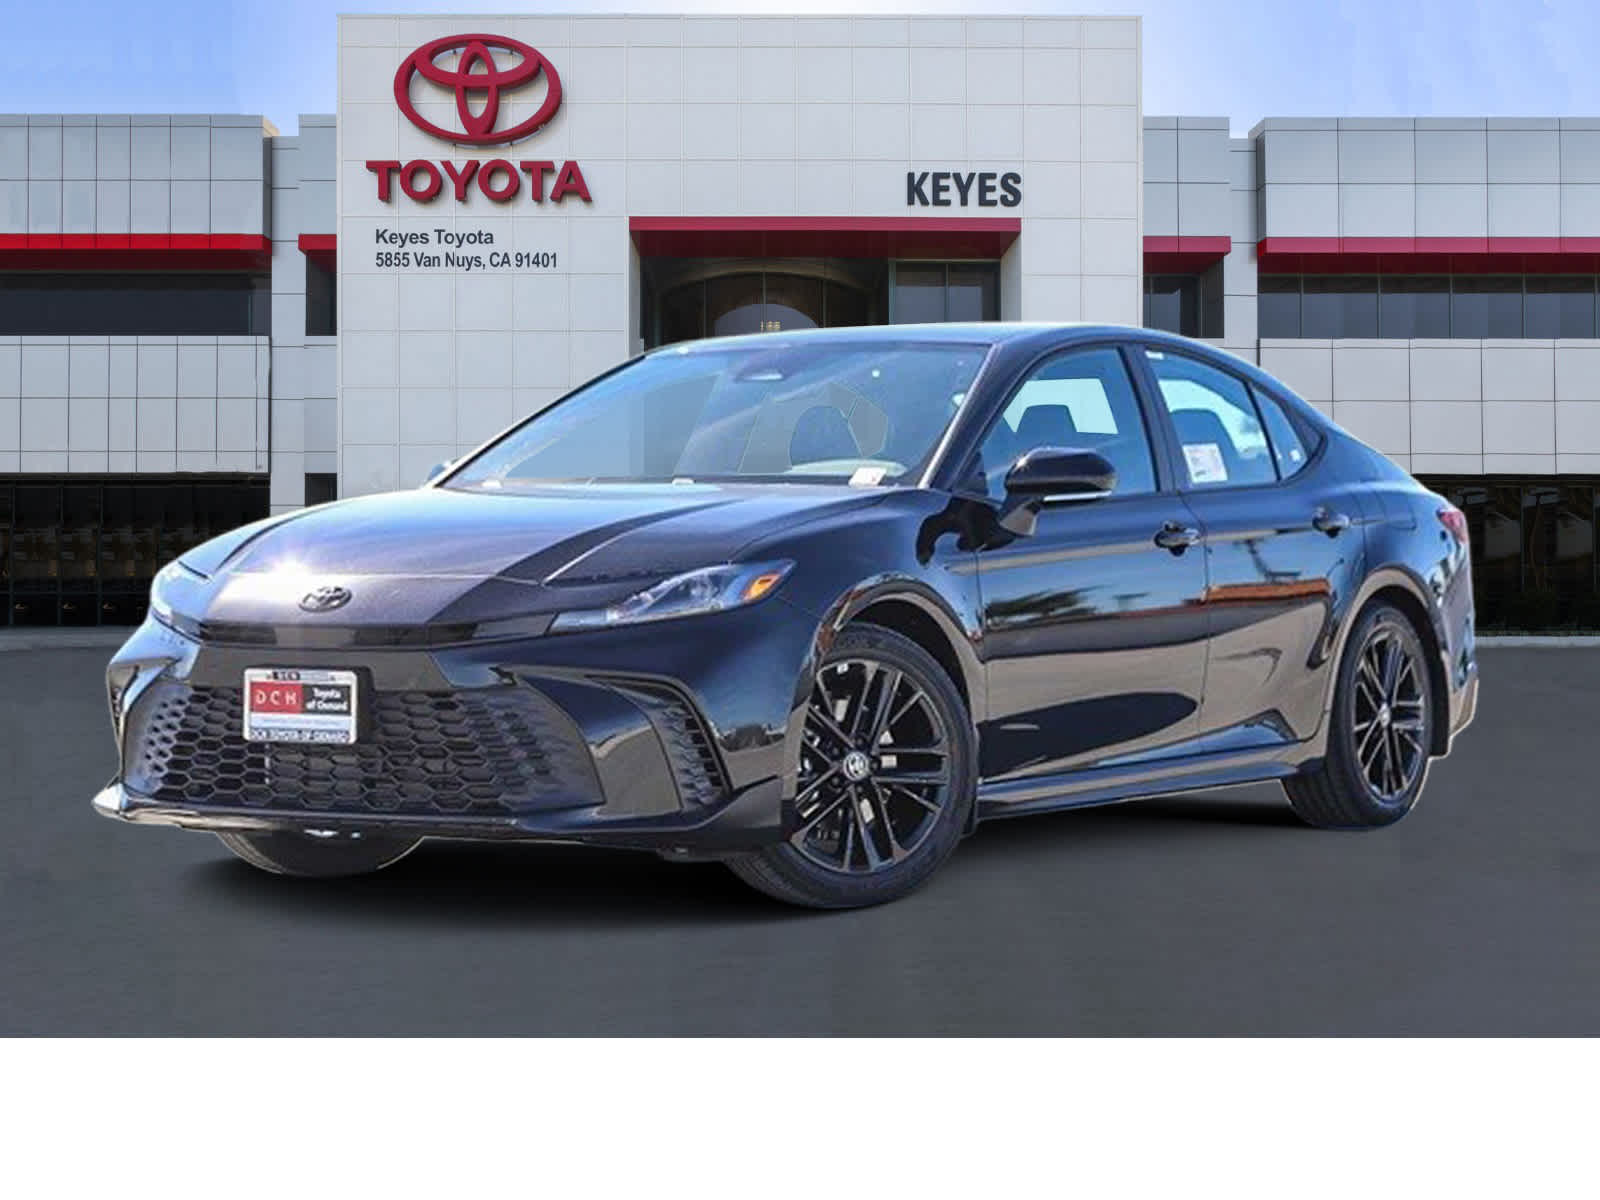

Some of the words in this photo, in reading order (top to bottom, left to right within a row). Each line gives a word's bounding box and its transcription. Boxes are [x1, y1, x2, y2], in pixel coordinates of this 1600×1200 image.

[365, 158, 593, 203] TOYOTA
[906, 171, 1022, 207] KEYES
[375, 229, 430, 248] Keyes
[434, 229, 494, 248] Toyota
[375, 252, 410, 268] 5855
[414, 252, 441, 268] Van
[445, 252, 486, 271] Nuys,
[489, 252, 511, 268] CA
[515, 252, 557, 268] 91401
